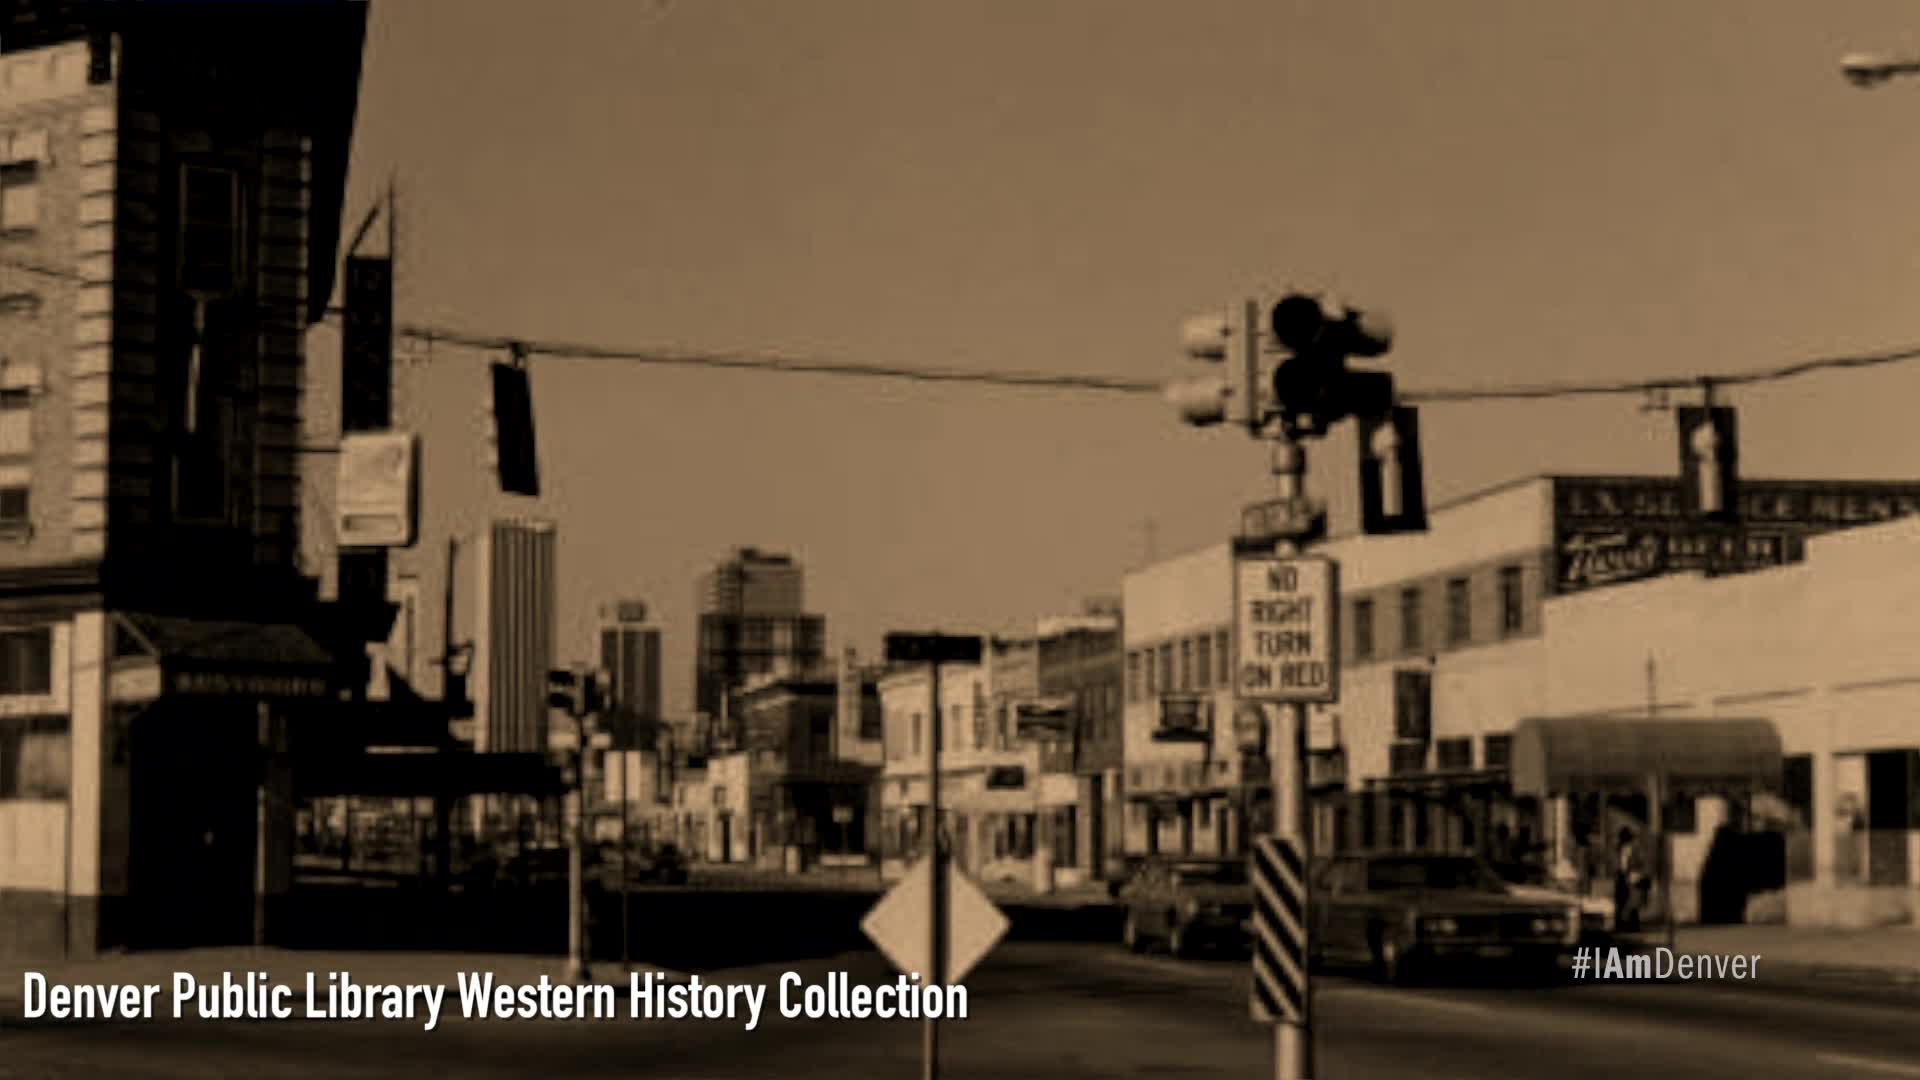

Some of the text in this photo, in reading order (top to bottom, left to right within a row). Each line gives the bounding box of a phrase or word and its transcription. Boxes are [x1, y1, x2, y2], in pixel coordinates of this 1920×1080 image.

[1268, 566, 1299, 592] NO
[1251, 597, 1312, 623] RIGHT
[1255, 631, 1312, 656] TURN
[1243, 661, 1327, 688] ON RED
